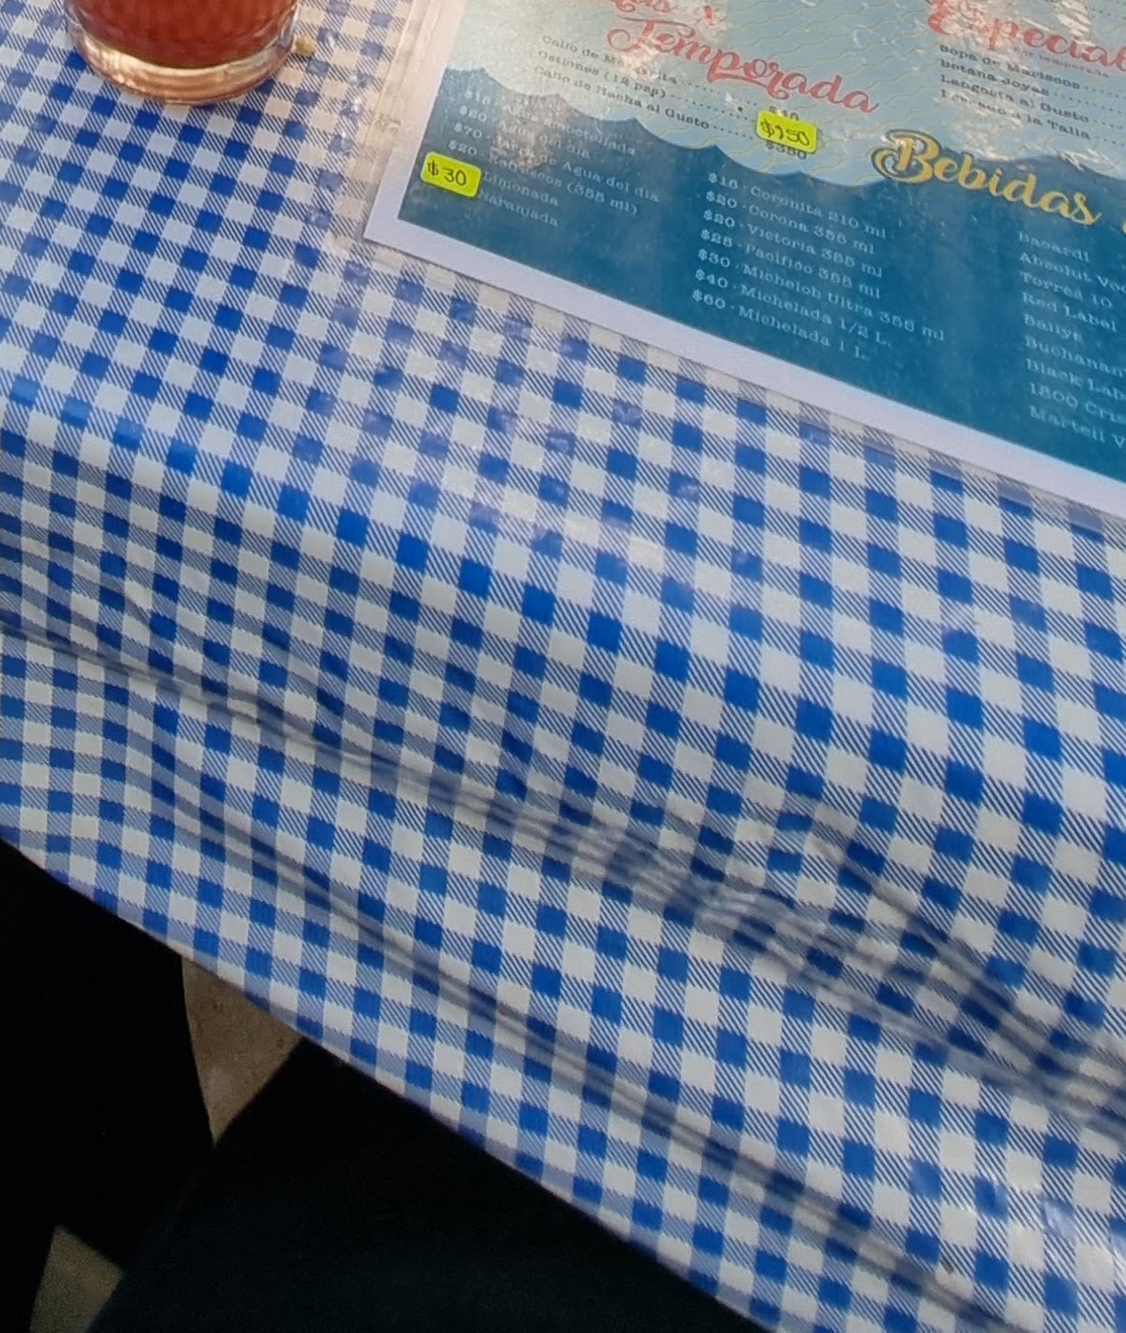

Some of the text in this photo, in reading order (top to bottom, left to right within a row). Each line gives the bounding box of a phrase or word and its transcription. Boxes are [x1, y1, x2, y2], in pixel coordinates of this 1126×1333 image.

[538, 49, 601, 77] Ostiones
[542, 35, 599, 60] Callo de
[606, 15, 880, 115] Temporada
[534, 65, 711, 131] Callo de Hacha al Gusto
[1040, 101, 1091, 124] Gusto
[760, 119, 812, 147] $150
[562, 159, 602, 183] Agua
[605, 172, 630, 194] del
[870, 128, 1103, 227] Bebidas
[706, 190, 738, 209] $20
[747, 203, 810, 234] Corona
[853, 238, 876, 255] ml
[863, 223, 887, 241] ml
[703, 208, 736, 229] $20
[746, 222, 817, 257] Victoria
[861, 261, 884, 279] ml
[1018, 251, 1093, 284] Absolut
[694, 267, 729, 289] $40
[739, 282, 833, 326] Michelada
[838, 316, 870, 341] 1/2
[741, 262, 823, 301] Michelob
[827, 290, 875, 320] Ultra
[922, 325, 947, 342] ml
[858, 282, 882, 300] ml
[1091, 292, 1114, 309] 10
[691, 288, 726, 311] $60
[736, 304, 832, 348] Michelada
[1063, 304, 1119, 333] Label
[1025, 357, 1083, 389] Black
[1029, 380, 1079, 409] 1800
